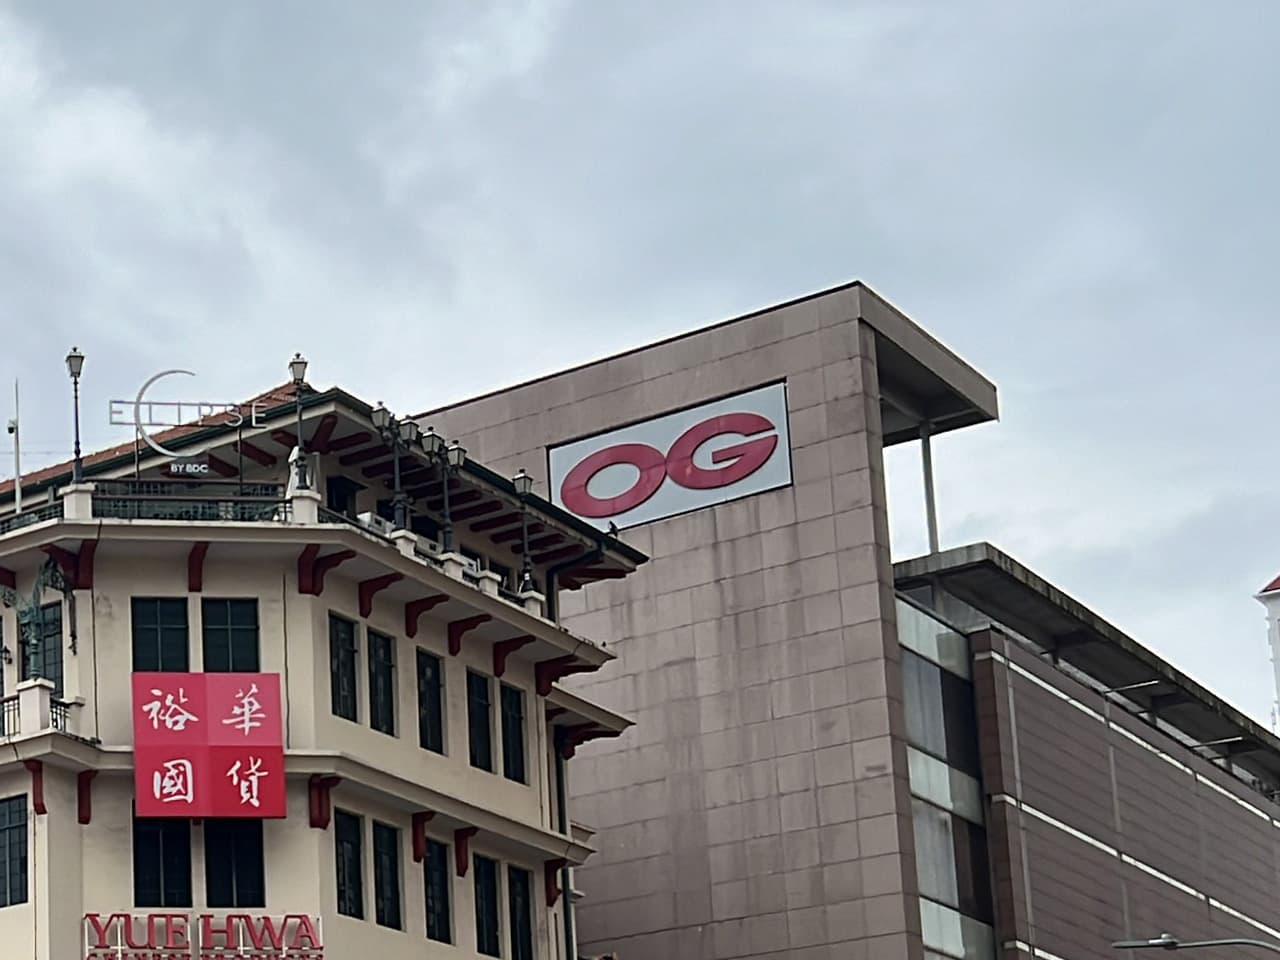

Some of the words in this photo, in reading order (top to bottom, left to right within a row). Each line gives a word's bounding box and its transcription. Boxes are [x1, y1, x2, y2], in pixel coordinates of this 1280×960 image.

[171, 464, 184, 472] BY
[561, 412, 778, 518] OG
[84, 914, 191, 949] YUE
[199, 914, 324, 950] HWA
